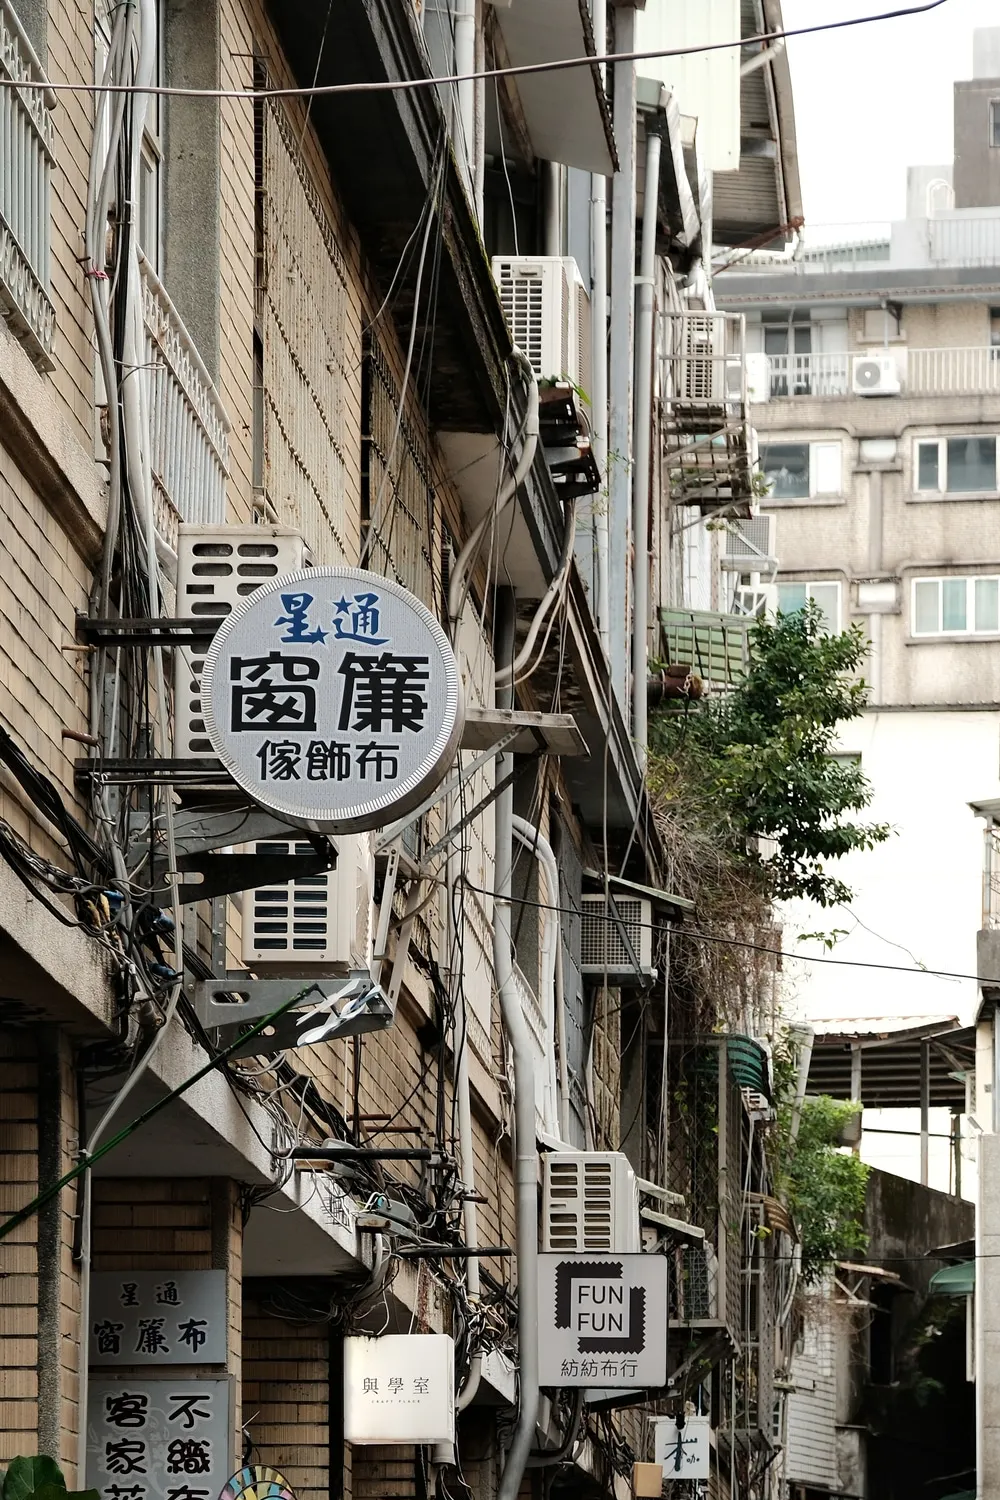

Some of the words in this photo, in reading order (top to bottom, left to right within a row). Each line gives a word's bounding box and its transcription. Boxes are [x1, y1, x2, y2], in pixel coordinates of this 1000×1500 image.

[274, 592, 390, 646] 星通
[230, 651, 430, 733] 窗簾
[256, 739, 401, 782] 傢飾布
[120, 1281, 181, 1306] 星通
[578, 1285, 623, 1304] FUN
[578, 1313, 623, 1332] FUN
[93, 1318, 208, 1355] 窗簾布
[560, 1359, 638, 1378] 紡紡布行
[362, 1377, 429, 1395] 與學室
